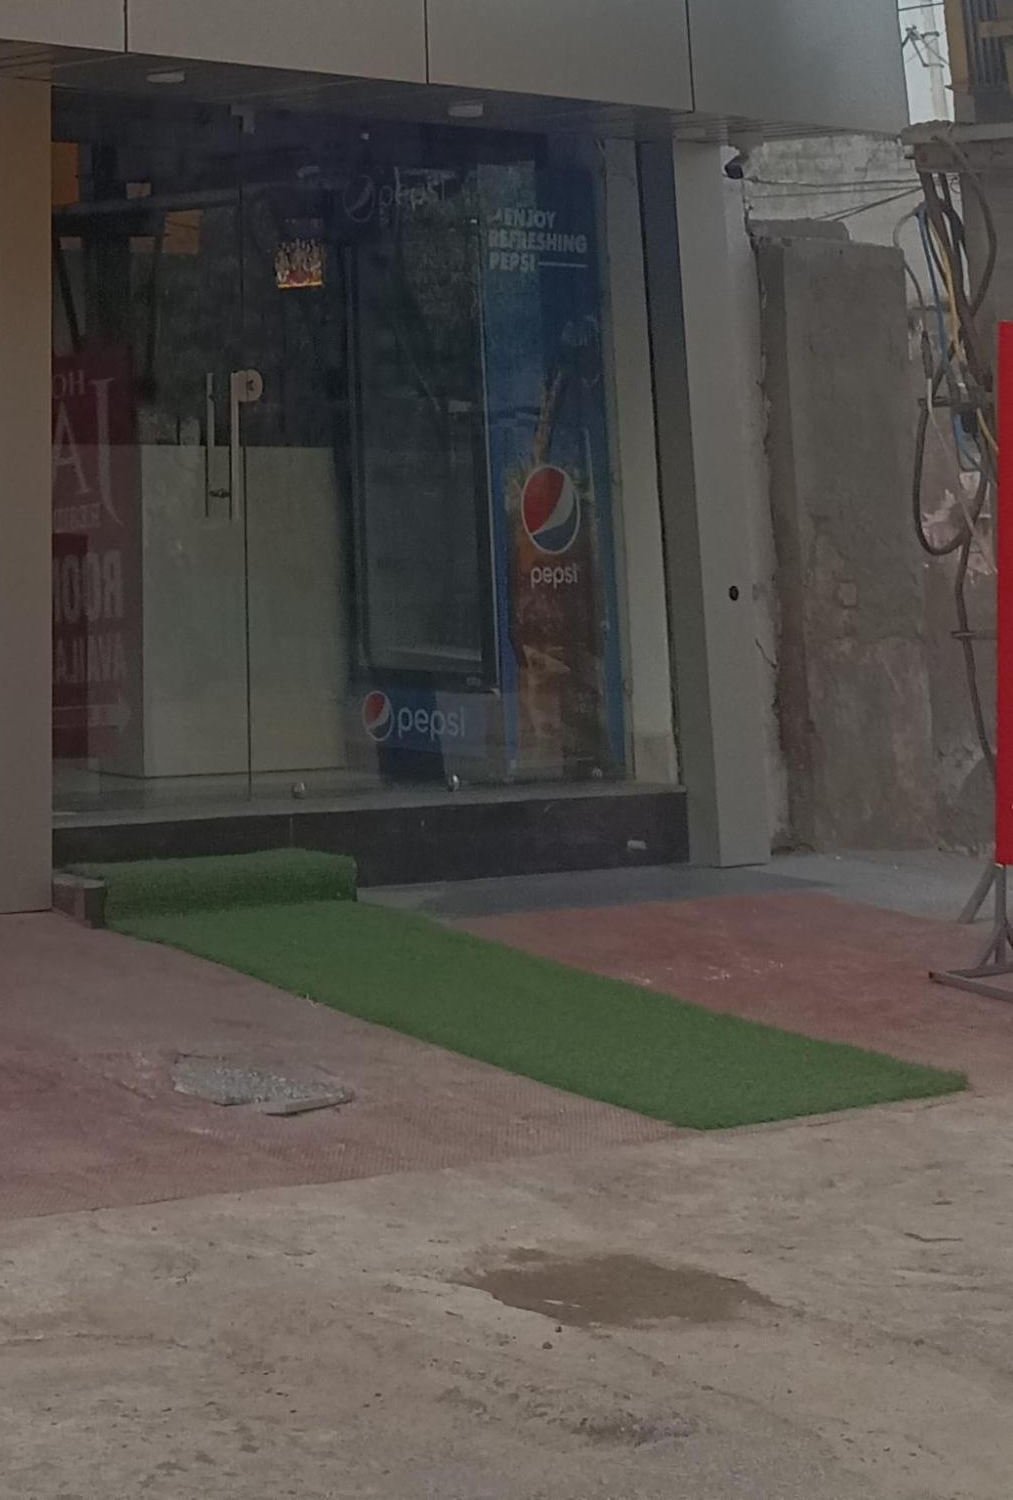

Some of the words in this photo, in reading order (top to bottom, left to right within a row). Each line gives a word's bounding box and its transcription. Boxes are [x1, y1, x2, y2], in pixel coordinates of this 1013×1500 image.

[504, 207, 557, 229] ENJOY
[488, 228, 588, 254] REFRESHING
[489, 250, 536, 273] PEPSI
[530, 562, 578, 589] pepsi
[397, 706, 466, 741] pepsi
